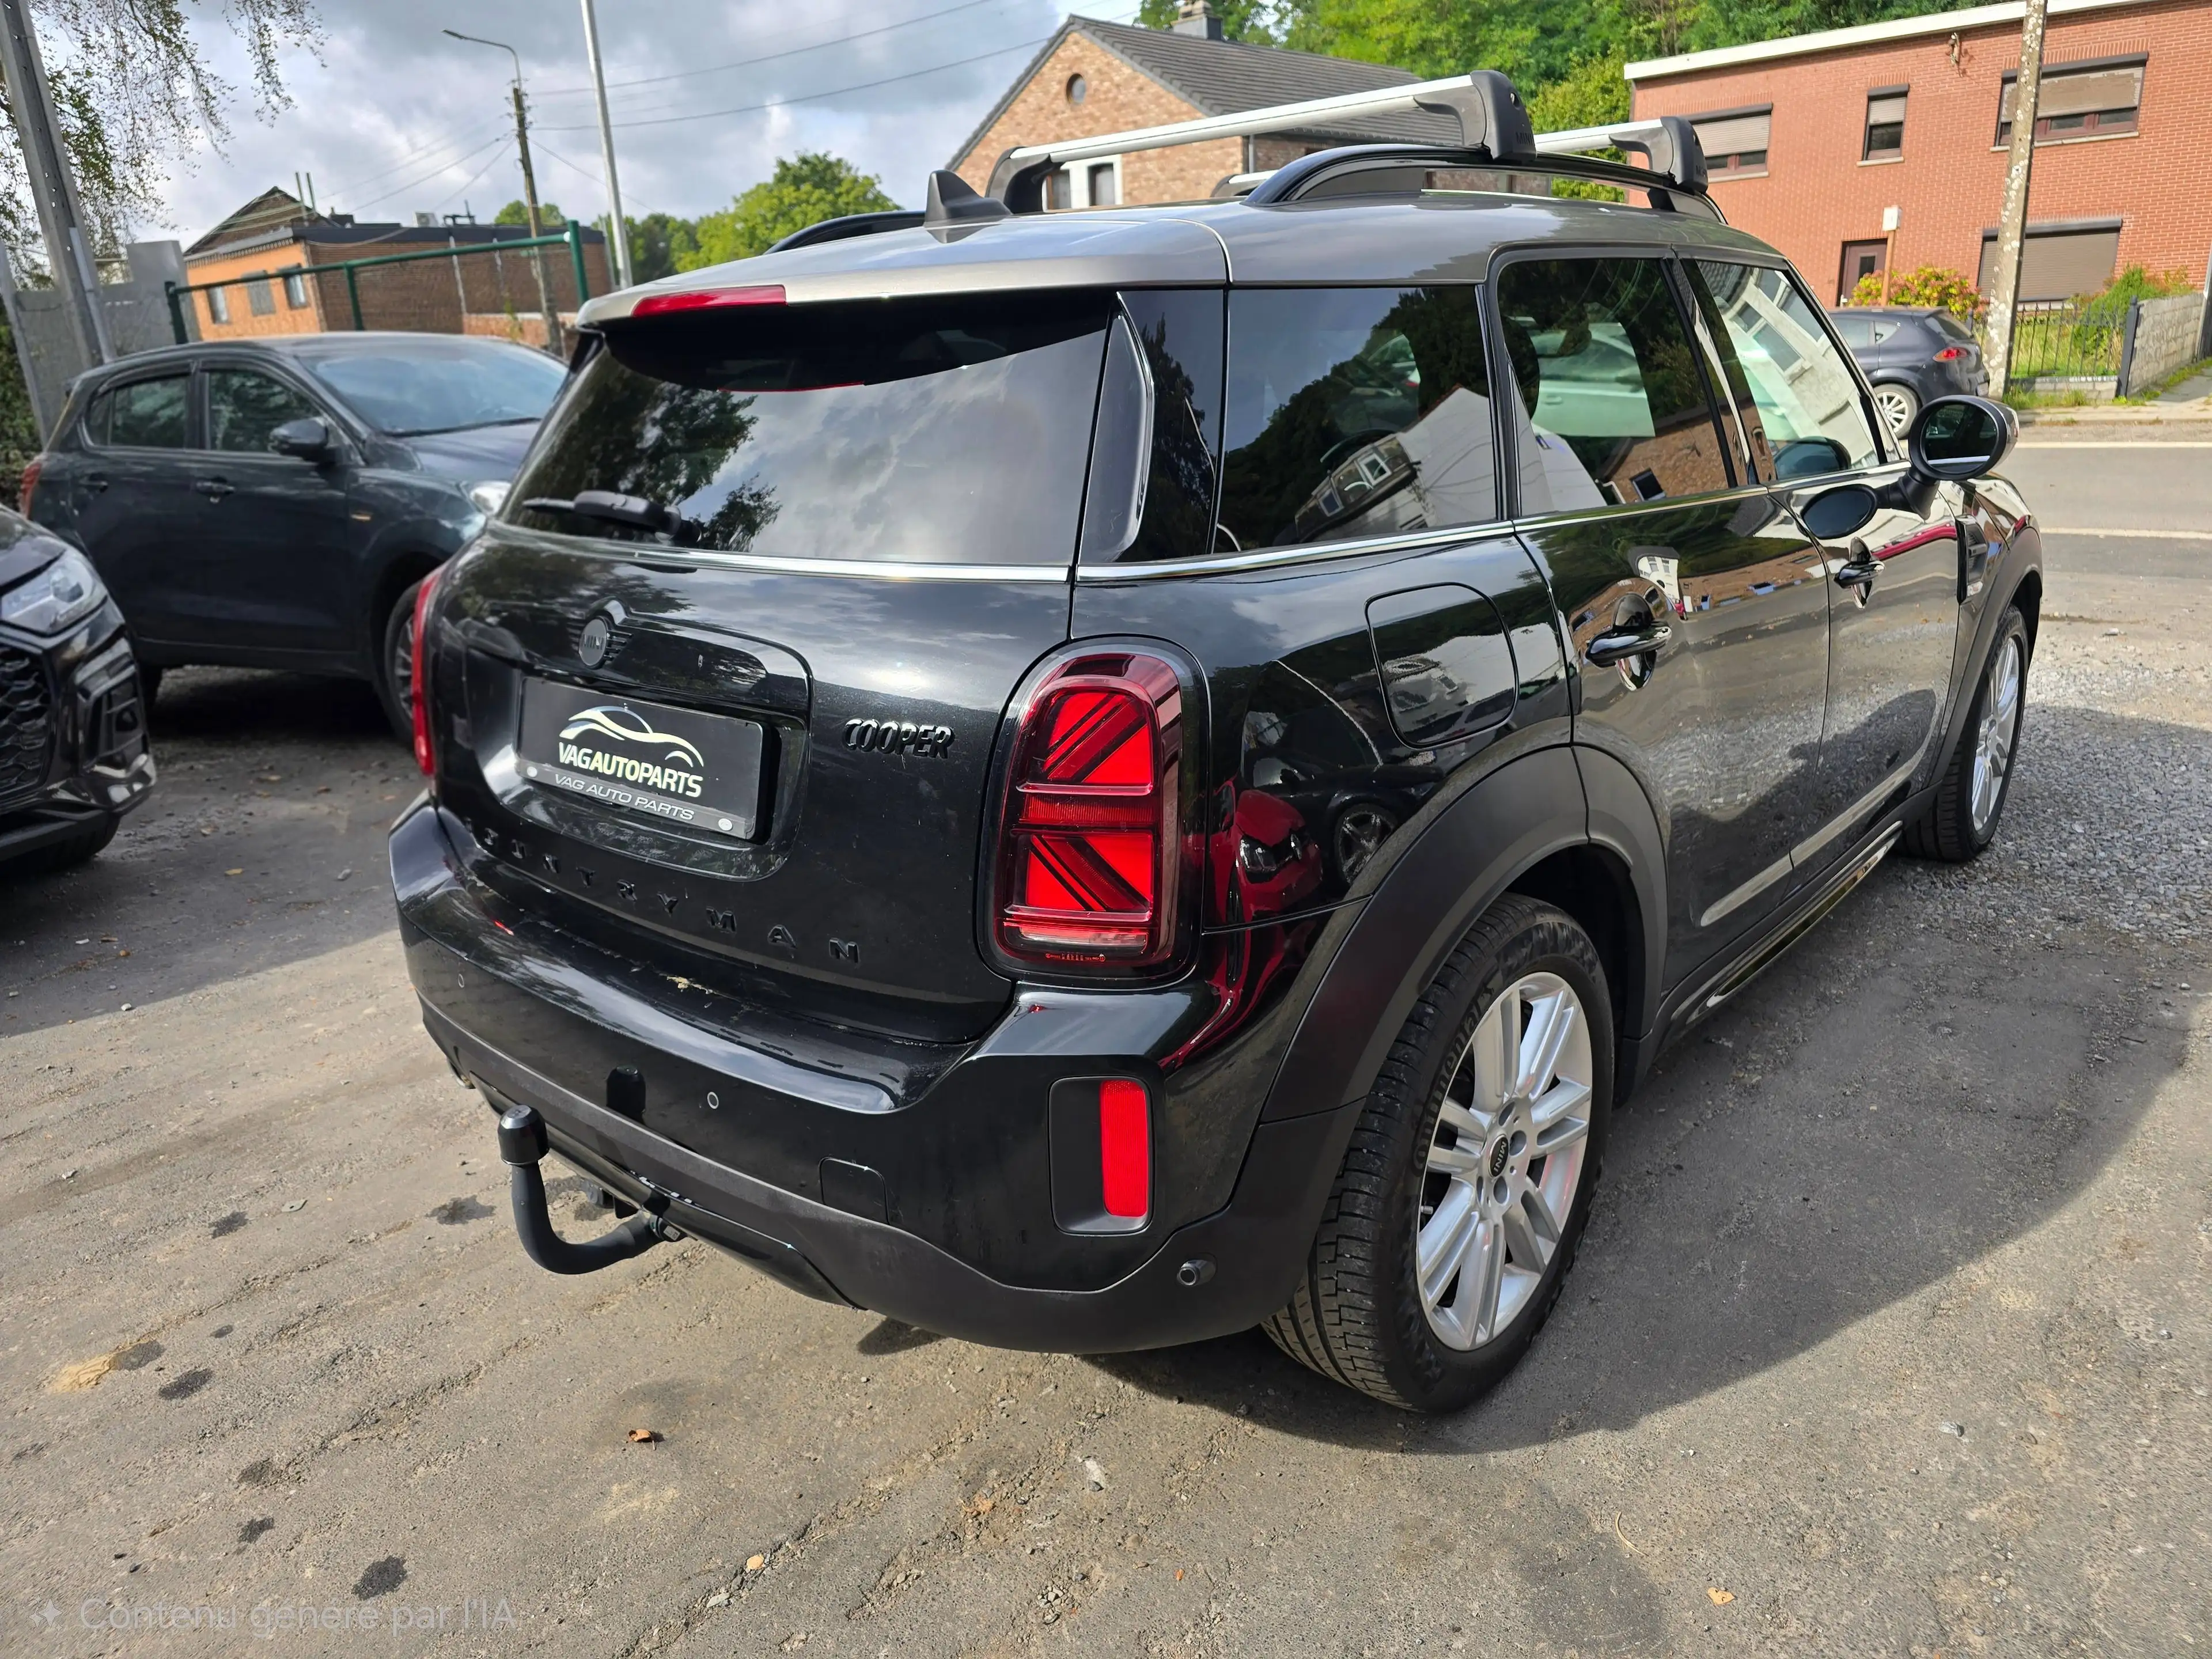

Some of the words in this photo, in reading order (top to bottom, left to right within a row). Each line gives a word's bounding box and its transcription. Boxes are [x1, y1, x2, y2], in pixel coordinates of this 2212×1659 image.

[842, 718, 955, 759] COOPER
[559, 742, 704, 798] VAGAUTOPARTS
[555, 773, 585, 791] VAG
[585, 783, 632, 804] AUTO
[634, 796, 695, 821] PARTS
[1494, 1141, 1507, 1172] MINI
